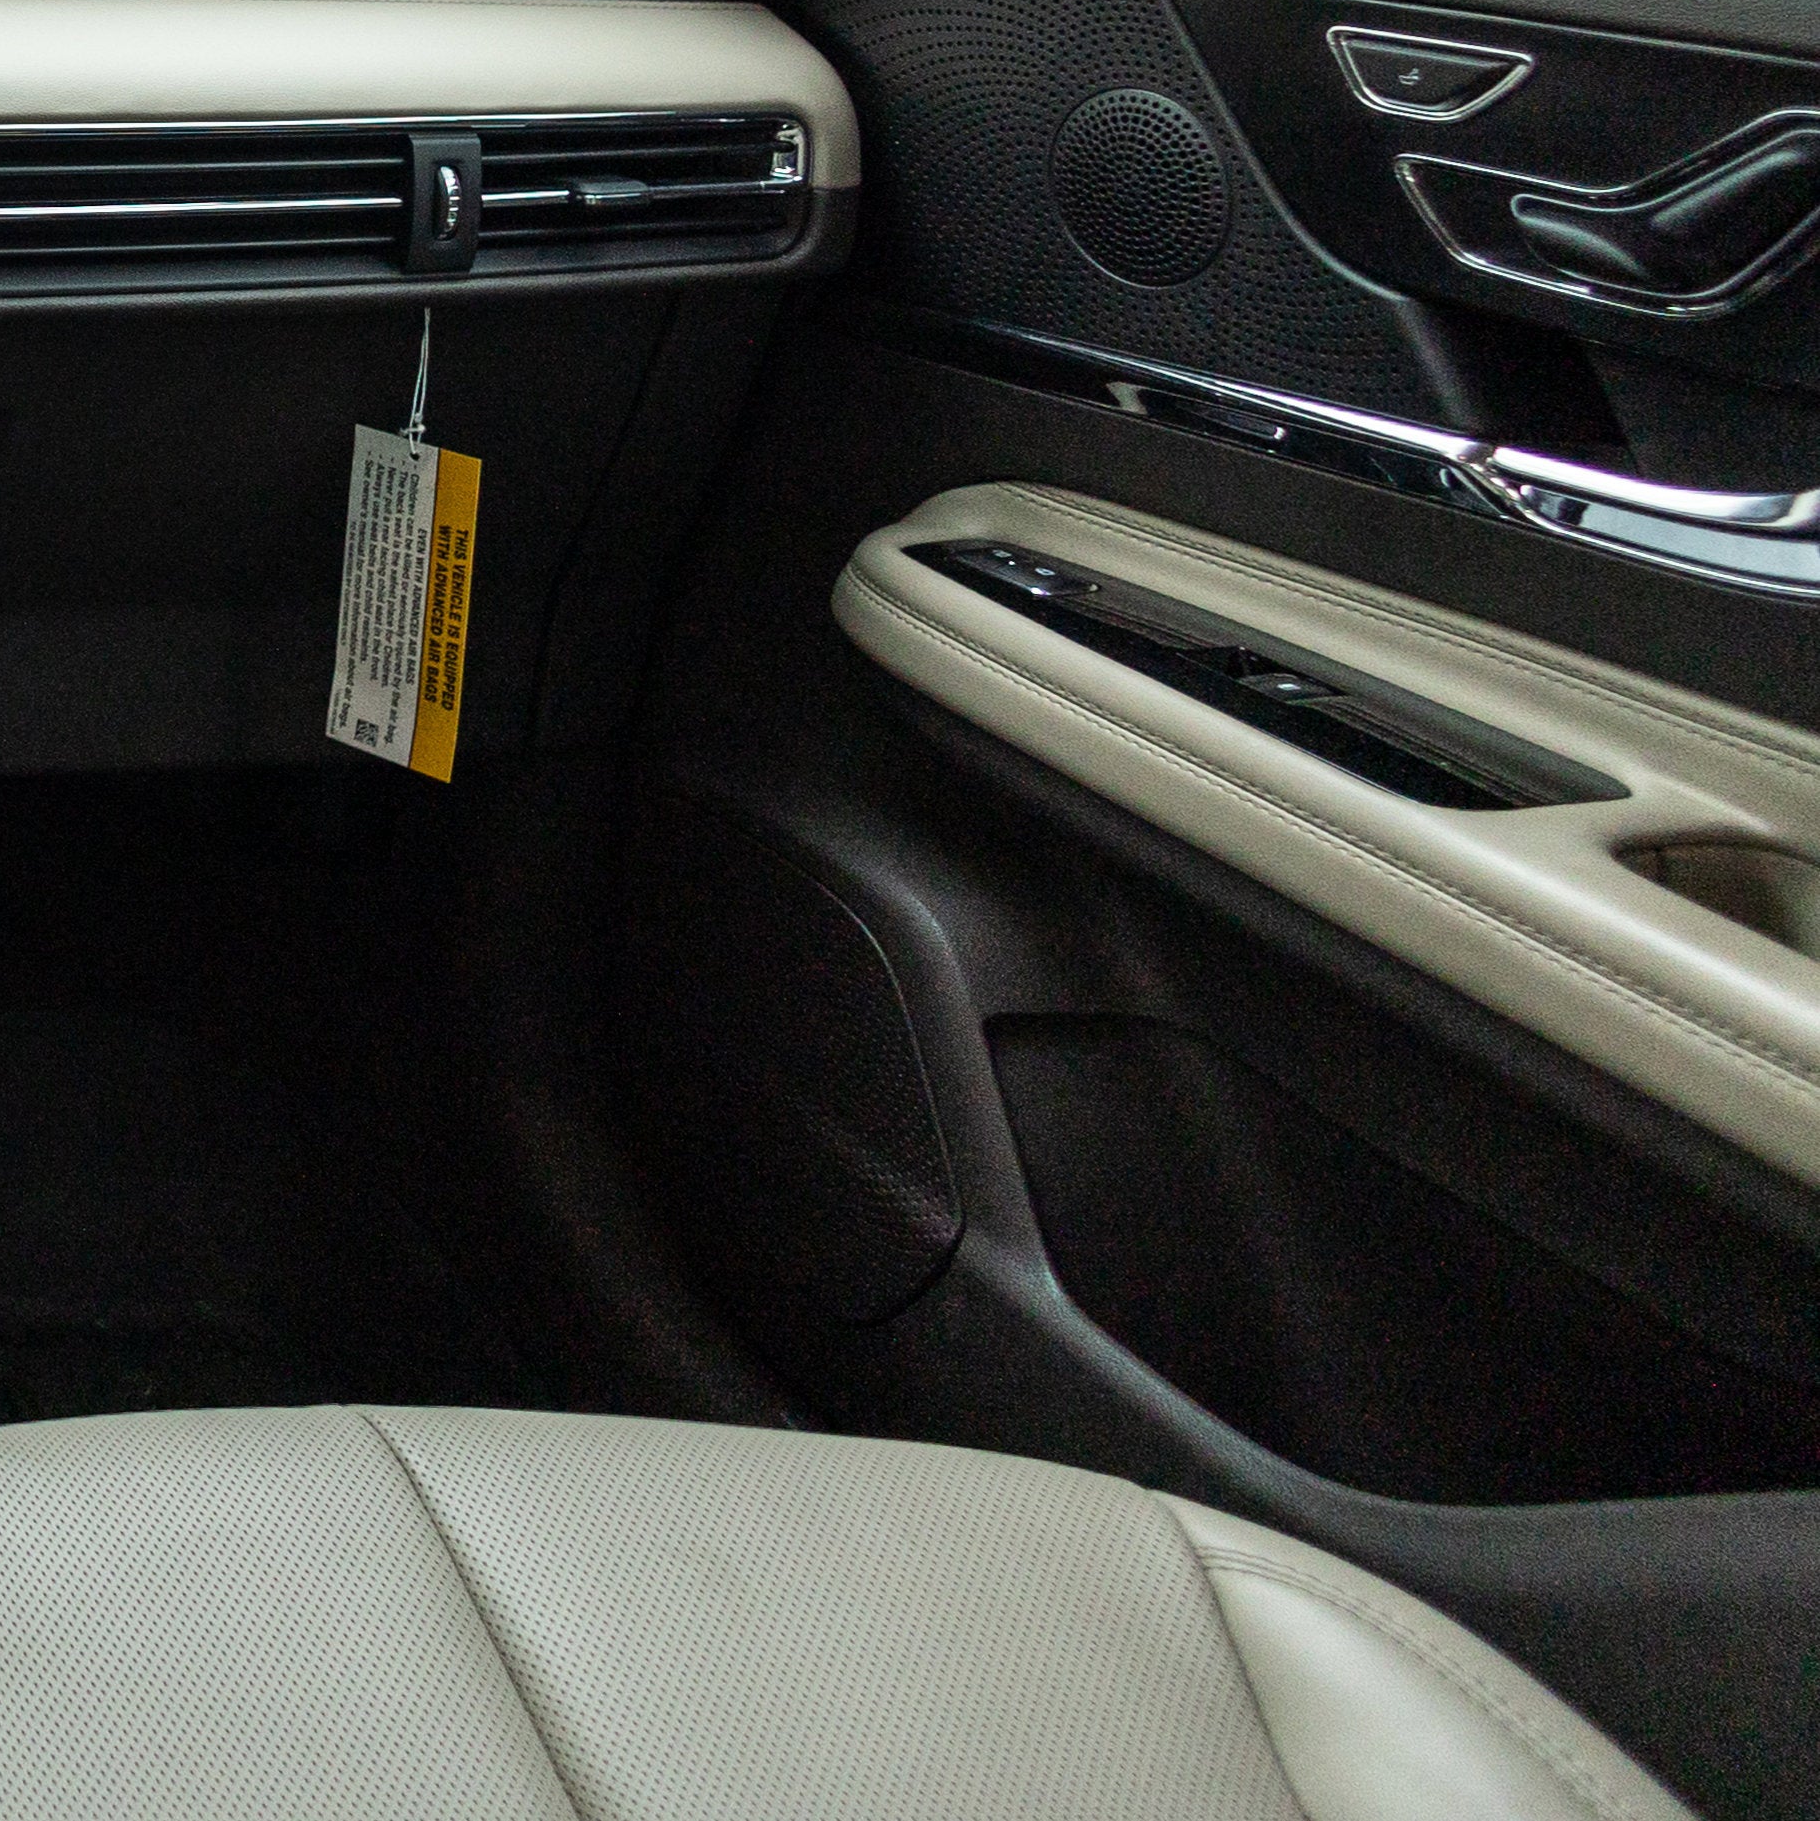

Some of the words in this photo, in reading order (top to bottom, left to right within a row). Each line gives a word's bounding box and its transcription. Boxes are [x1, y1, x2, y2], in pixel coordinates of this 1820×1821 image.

[364, 460, 374, 479] See
[373, 462, 385, 499] Always
[386, 466, 396, 495] Never
[398, 471, 408, 489] The
[360, 481, 371, 517] owner's
[383, 498, 394, 514] put
[395, 491, 406, 514] back
[407, 473, 420, 516] Children
[371, 501, 380, 519] use
[357, 521, 369, 556] manual
[369, 521, 380, 542] seat
[381, 525, 390, 545] rear
[393, 517, 404, 538] seat
[406, 517, 415, 537] can
[404, 538, 416, 551] be
[417, 528, 427, 555] EVEN
[437, 525, 451, 560] WITH
[454, 529, 468, 560] THIS
[378, 547, 389, 577] facing
[402, 553, 414, 579] killed
[414, 557, 425, 582] WITH
[353, 575, 363, 600] more
[367, 569, 377, 588] and
[376, 578, 387, 603] child
[401, 581, 409, 593] or
[364, 590, 375, 614] child
[431, 563, 448, 636] ADVANCED
[448, 564, 466, 622] VEHICLE
[374, 605, 385, 626] seat
[384, 601, 396, 627] place
[396, 594, 410, 639] seriously
[409, 585, 422, 637] ADVANCED
[349, 601, 361, 656] information
[447, 625, 460, 639] IS
[408, 639, 418, 656] AIR
[428, 638, 442, 663] AIR
[345, 657, 357, 686] about
[392, 677, 403, 689] by
[406, 658, 417, 685] BAGS
[441, 642, 458, 711] EQUIPPED
[424, 666, 440, 704] BAGS
[390, 692, 401, 706] the
[389, 709, 398, 724] air
